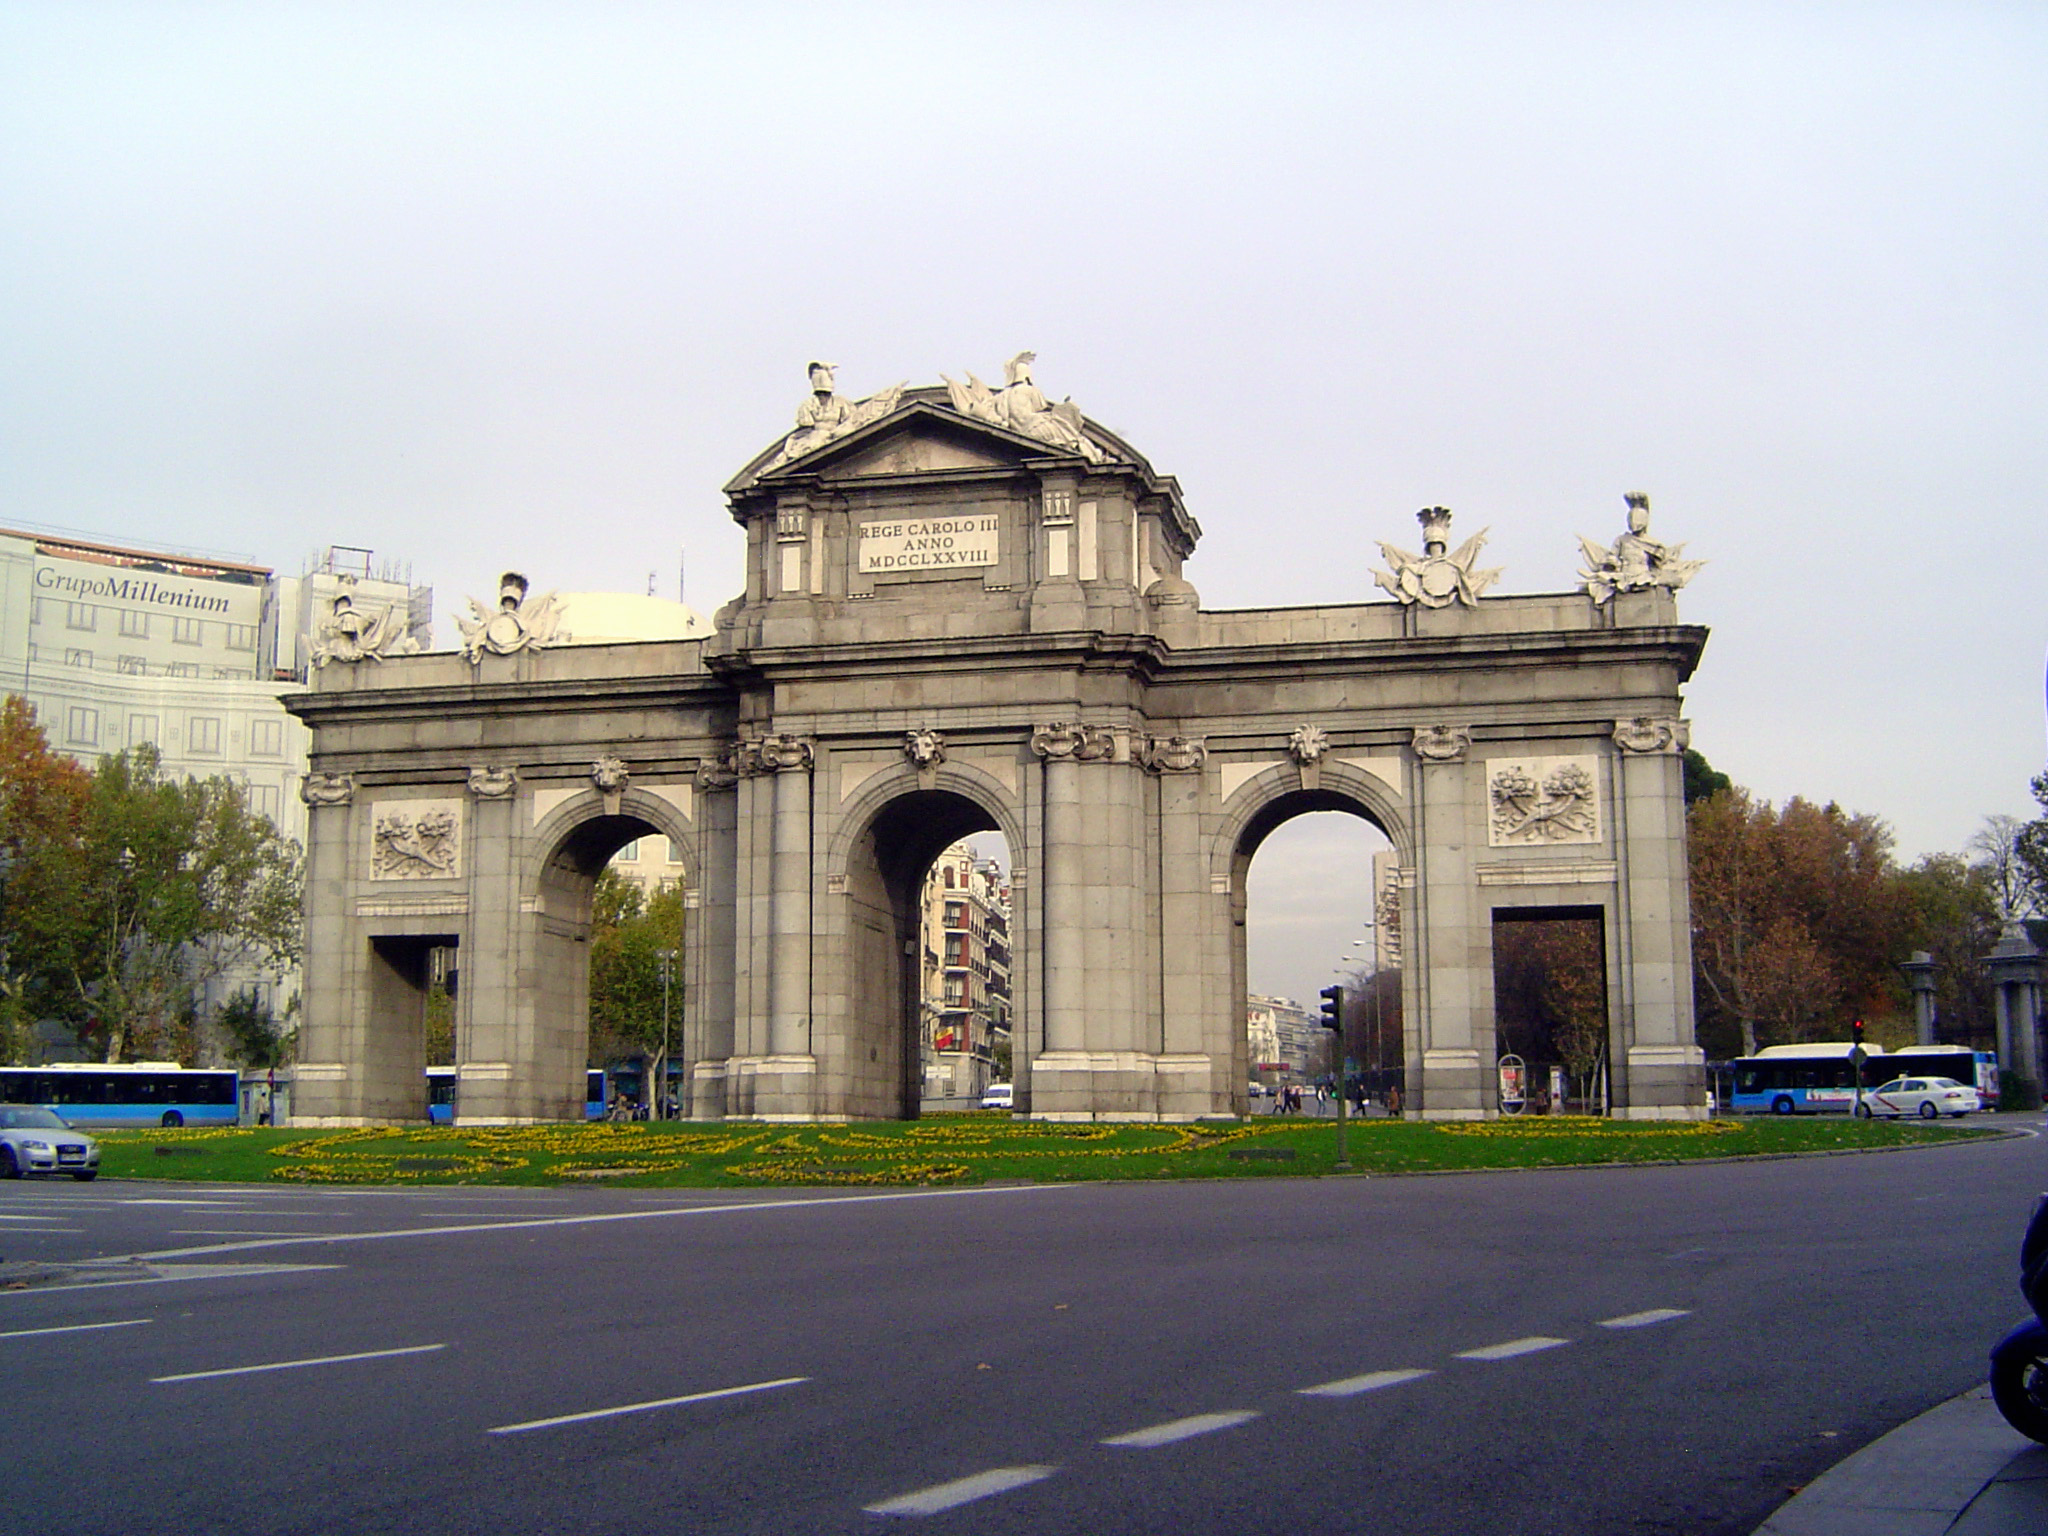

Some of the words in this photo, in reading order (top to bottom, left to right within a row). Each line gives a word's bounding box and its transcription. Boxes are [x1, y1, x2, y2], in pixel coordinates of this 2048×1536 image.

[859, 525, 903, 539] REGE
[908, 520, 975, 535] CAROLO
[980, 519, 998, 532] III
[903, 537, 954, 551] ANNO
[869, 549, 988, 568] MDCCLXXVIII
